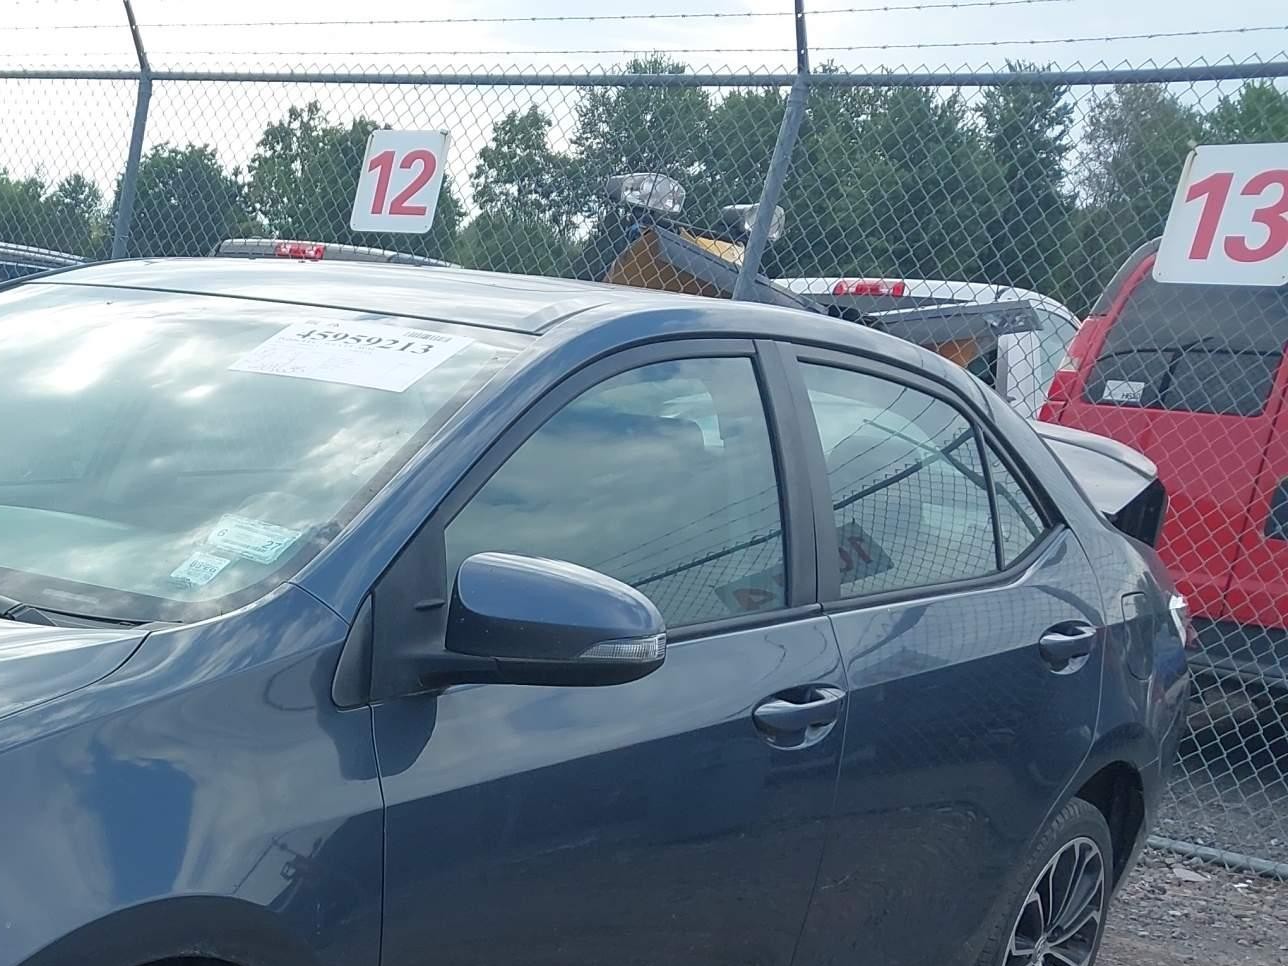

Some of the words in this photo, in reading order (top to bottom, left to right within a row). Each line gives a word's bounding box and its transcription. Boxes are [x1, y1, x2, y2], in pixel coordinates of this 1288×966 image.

[368, 149, 436, 216] 12
[1185, 169, 1288, 262] 13
[296, 328, 435, 355] 45959213
